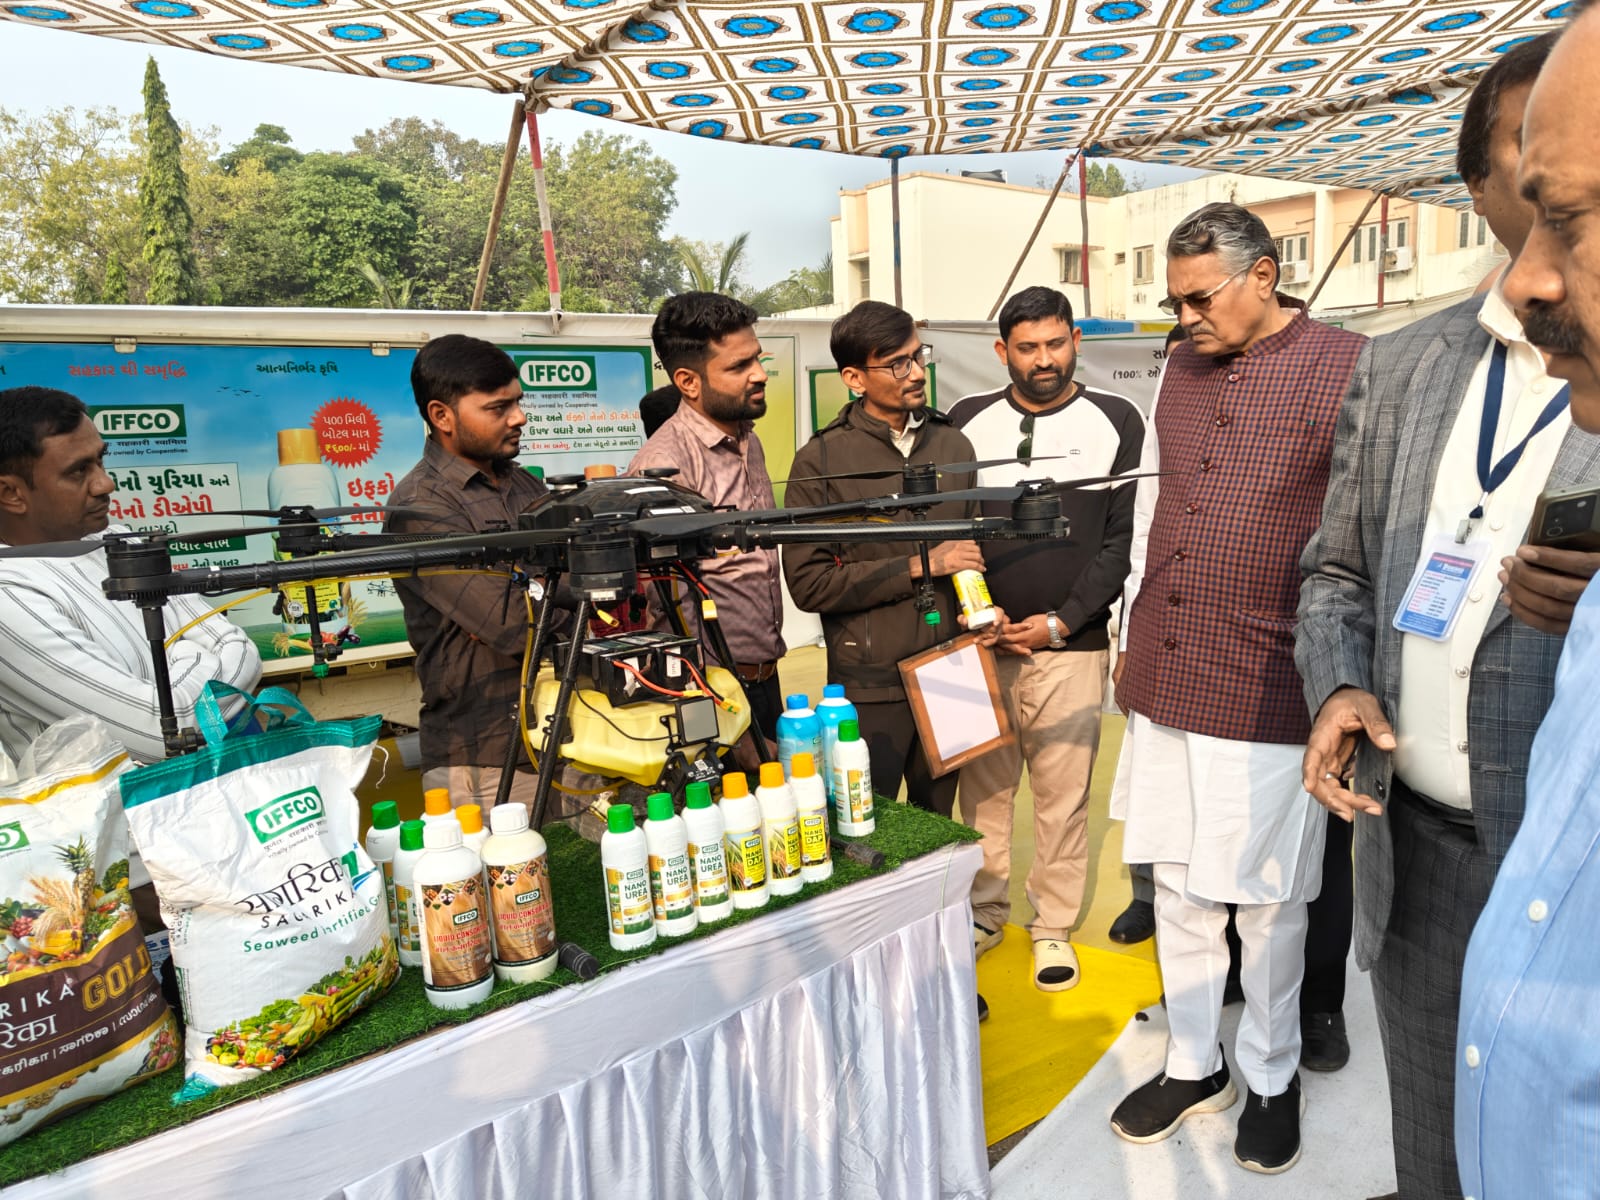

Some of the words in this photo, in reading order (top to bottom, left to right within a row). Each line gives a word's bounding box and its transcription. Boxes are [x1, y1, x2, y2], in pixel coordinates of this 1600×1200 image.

[68, 364, 117, 377] સહકાર
[120, 361, 139, 376] થી
[143, 360, 188, 380] સમૃદ્ધિ
[255, 361, 317, 374] આત્મનિર્ભર
[319, 361, 339, 376] કૃષિ
[528, 364, 585, 382] IFFCO
[102, 412, 171, 431] IFFCO
[577, 423, 593, 433] અને
[137, 448, 145, 456] by
[148, 469, 204, 494] યુરિયા
[209, 474, 230, 487] અને
[152, 494, 214, 518] ડીએપી
[262, 796, 318, 829] IFFCO
[805, 828, 823, 836] NANO
[806, 836, 824, 845] DAP
[700, 854, 722, 865] NANO
[666, 866, 688, 878] NANO
[701, 861, 723, 872] UREA
[624, 879, 647, 892] NANO
[667, 875, 689, 886] UREA
[519, 892, 538, 902] IFFCO
[625, 888, 648, 900] UREA
[457, 910, 476, 923] IFFCO
[243, 927, 319, 953] Seaweed
[0, 983, 75, 1020] RIKA
[82, 953, 152, 1013] GOLD
[0, 1051, 50, 1076] கரிகா
